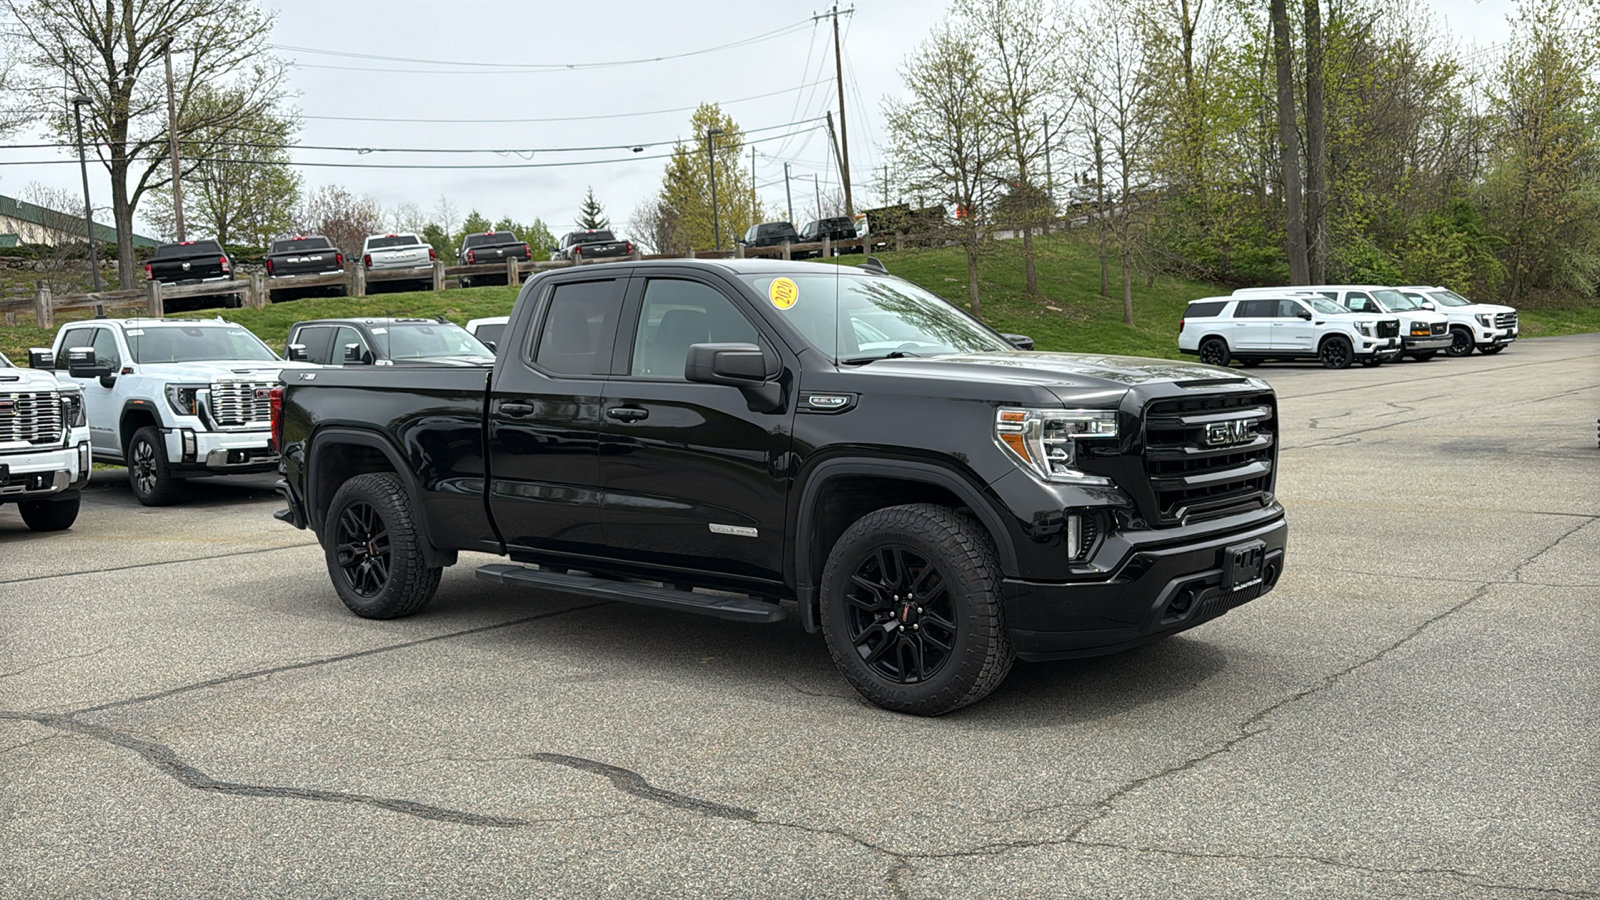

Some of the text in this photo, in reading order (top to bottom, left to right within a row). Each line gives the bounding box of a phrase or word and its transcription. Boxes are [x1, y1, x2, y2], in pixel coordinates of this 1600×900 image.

[286, 255, 322, 263] RAM
[775, 280, 793, 305] 2020
[1205, 419, 1258, 445] GMC
